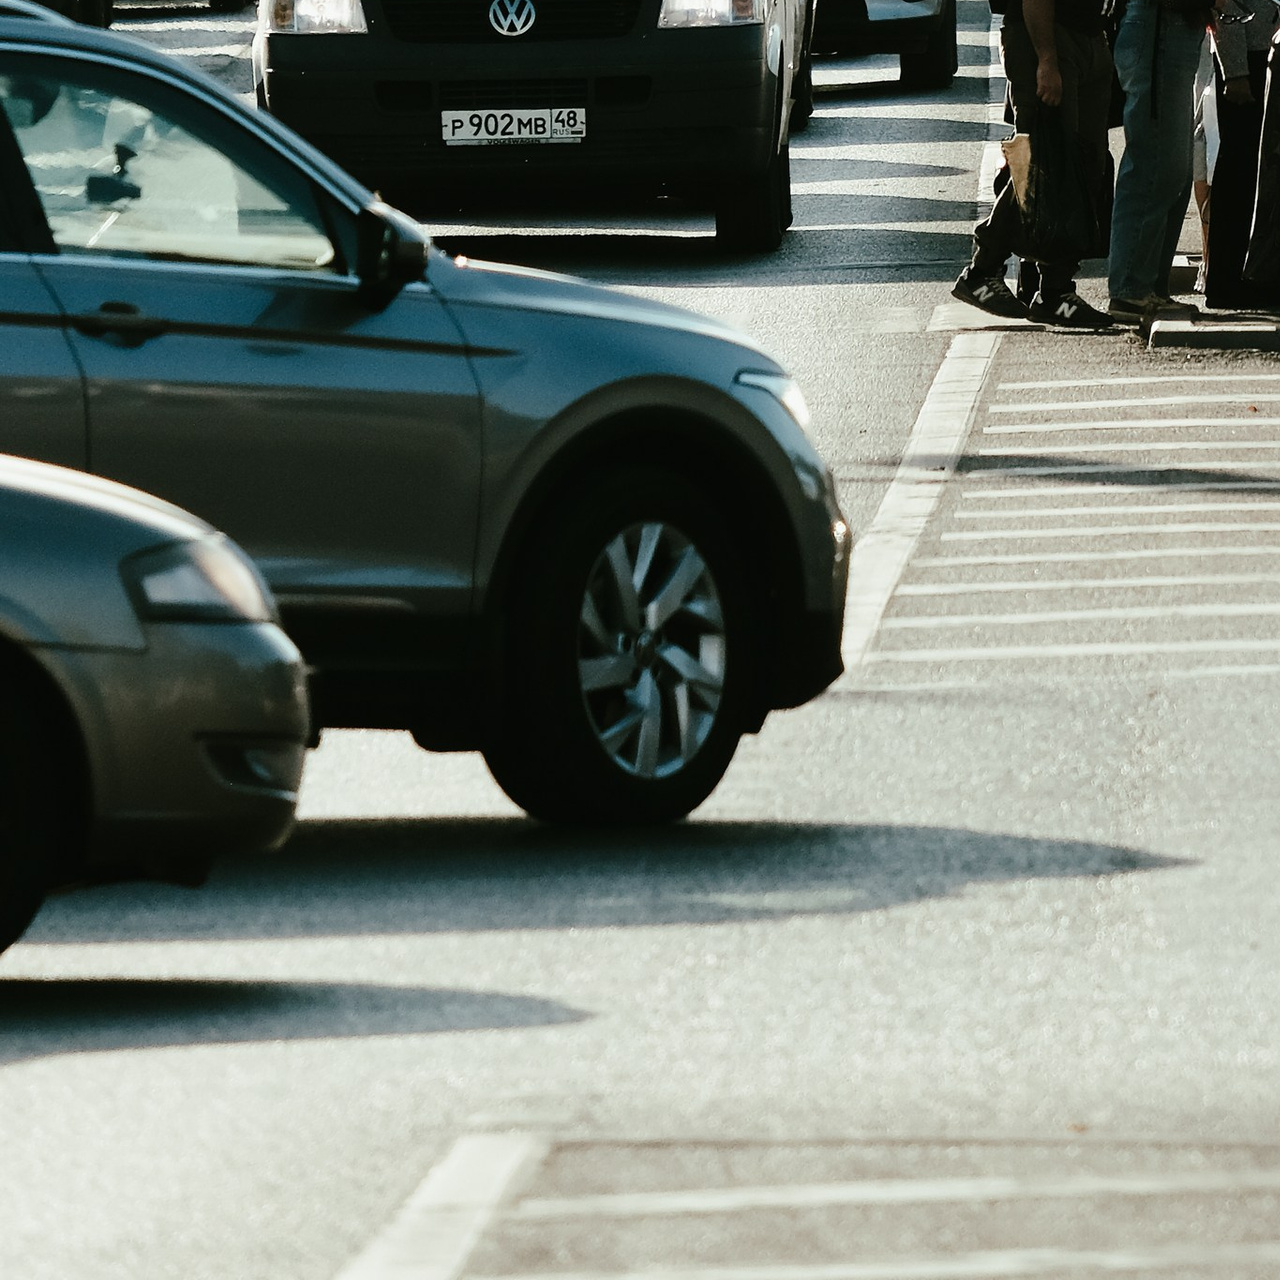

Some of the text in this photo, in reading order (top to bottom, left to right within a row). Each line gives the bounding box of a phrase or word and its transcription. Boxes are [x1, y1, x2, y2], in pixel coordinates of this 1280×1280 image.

[554, 110, 578, 128] 48
[552, 128, 570, 136] RUS
[972, 285, 994, 303] N
[1054, 301, 1078, 319] N
